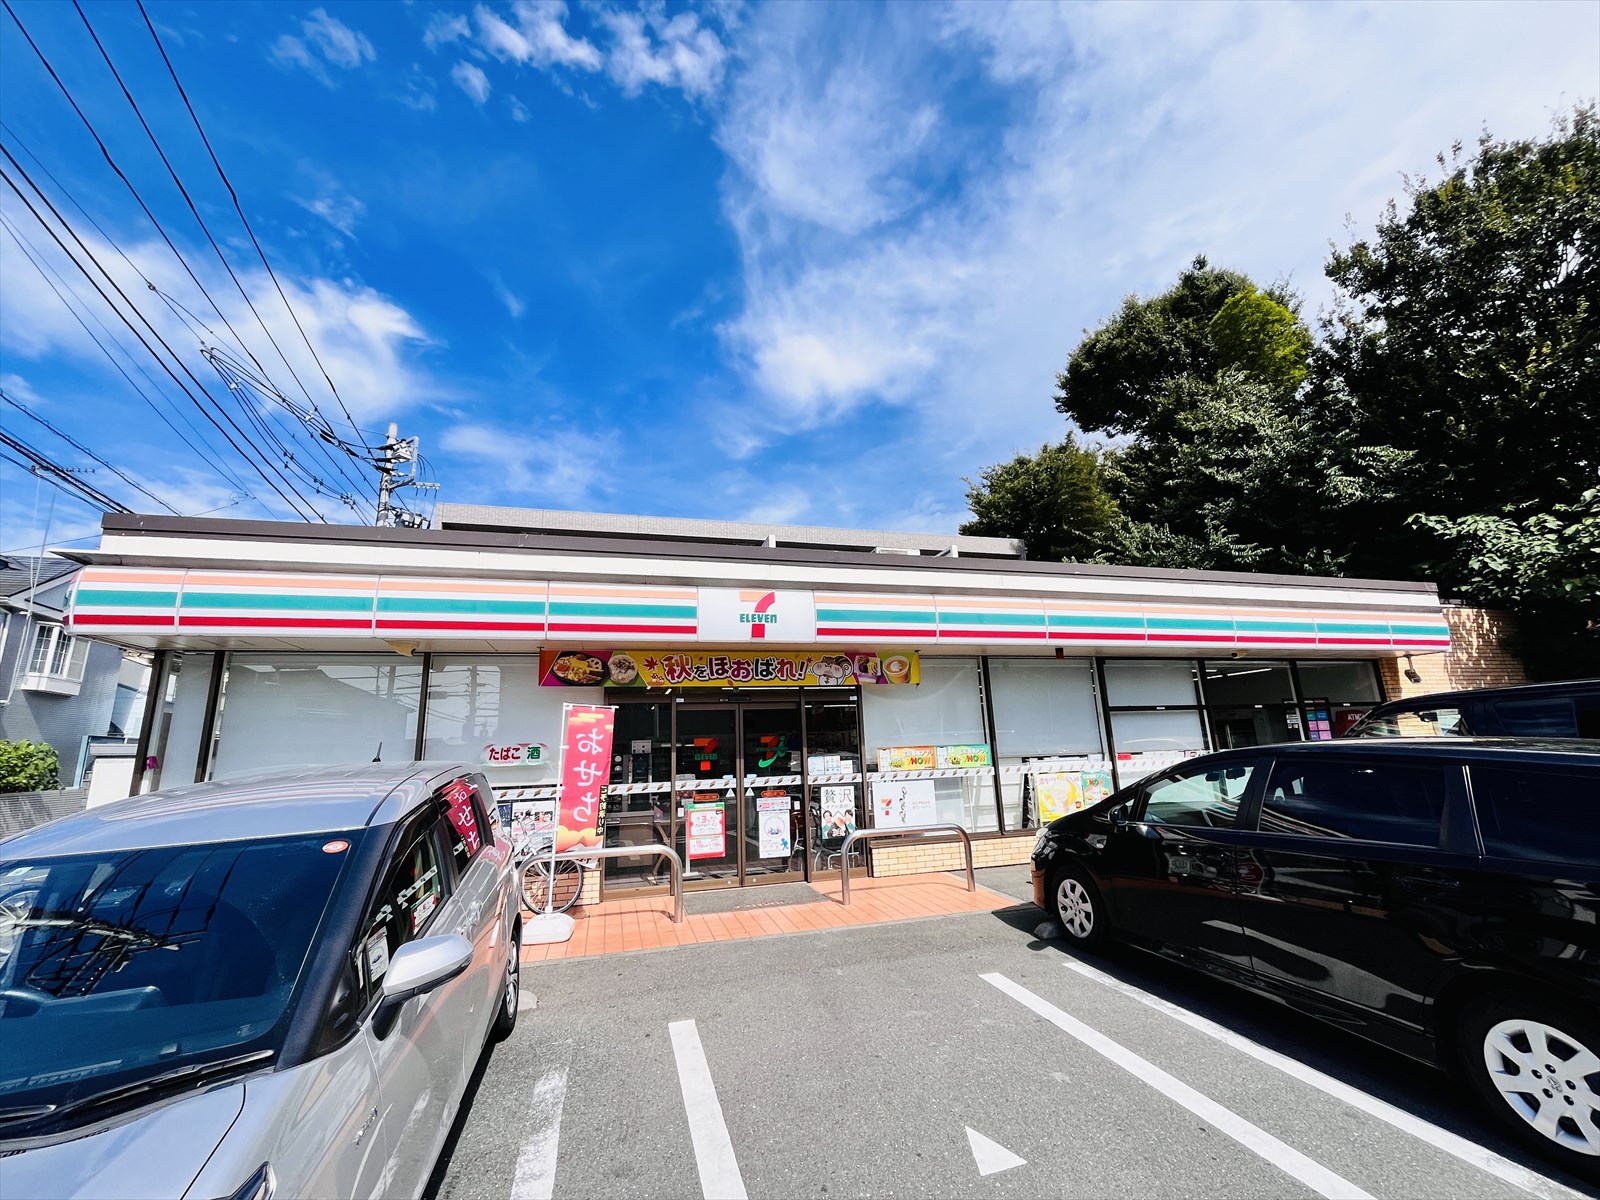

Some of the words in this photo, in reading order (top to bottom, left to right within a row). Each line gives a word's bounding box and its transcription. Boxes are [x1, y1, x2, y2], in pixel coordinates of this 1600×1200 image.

[740, 592, 775, 638] 7
[662, 654, 807, 682] 秋をほおばれ!
[488, 747, 521, 760] たばこ
[526, 746, 541, 760] 酒
[824, 788, 853, 804] 贅沢
